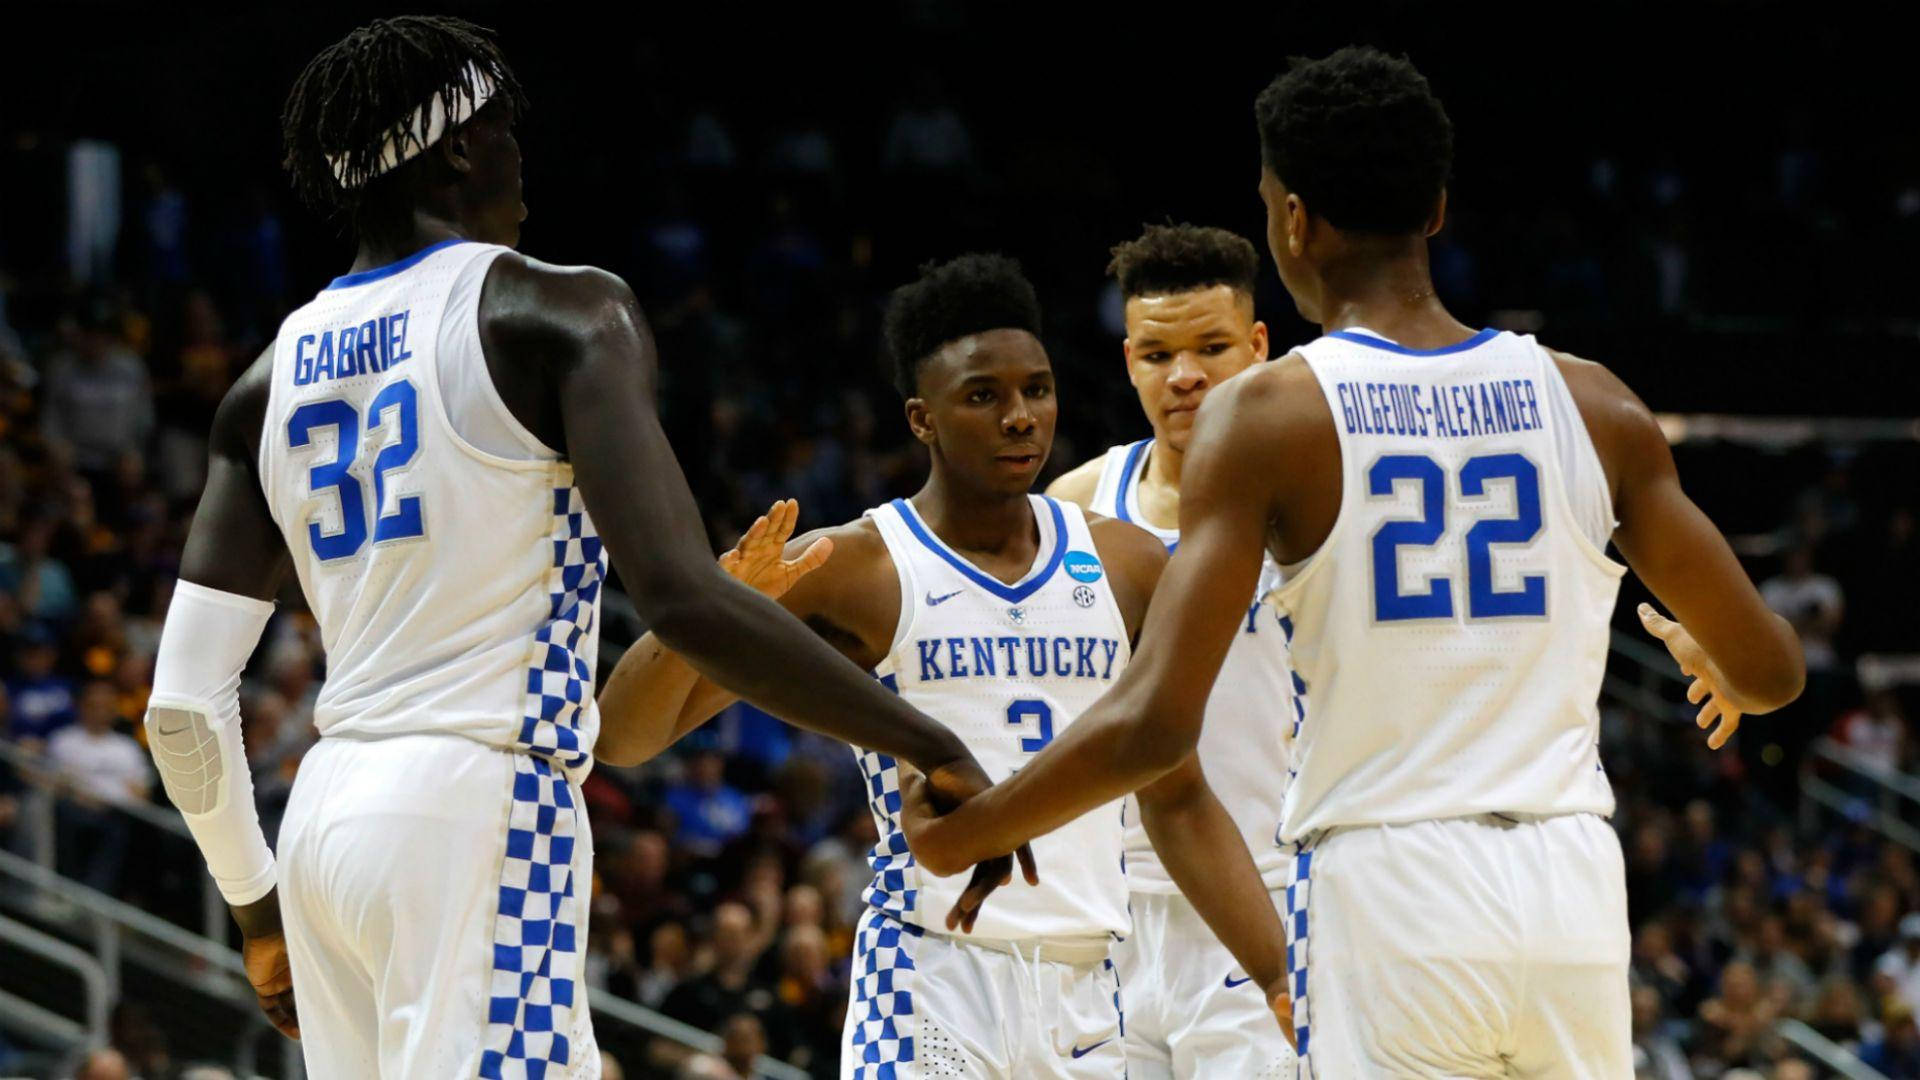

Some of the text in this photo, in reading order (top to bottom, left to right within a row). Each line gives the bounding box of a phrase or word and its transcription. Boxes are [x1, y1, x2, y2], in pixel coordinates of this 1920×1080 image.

[294, 310, 412, 386] GABRIEL
[1337, 379, 1543, 437] GILGEOUS-ALEXANDER
[287, 378, 425, 561] 32
[1368, 453, 1547, 621] 22
[1070, 564, 1101, 574] NCAA
[1074, 586, 1095, 607] SEC
[917, 637, 1118, 681] KENTUCKY
